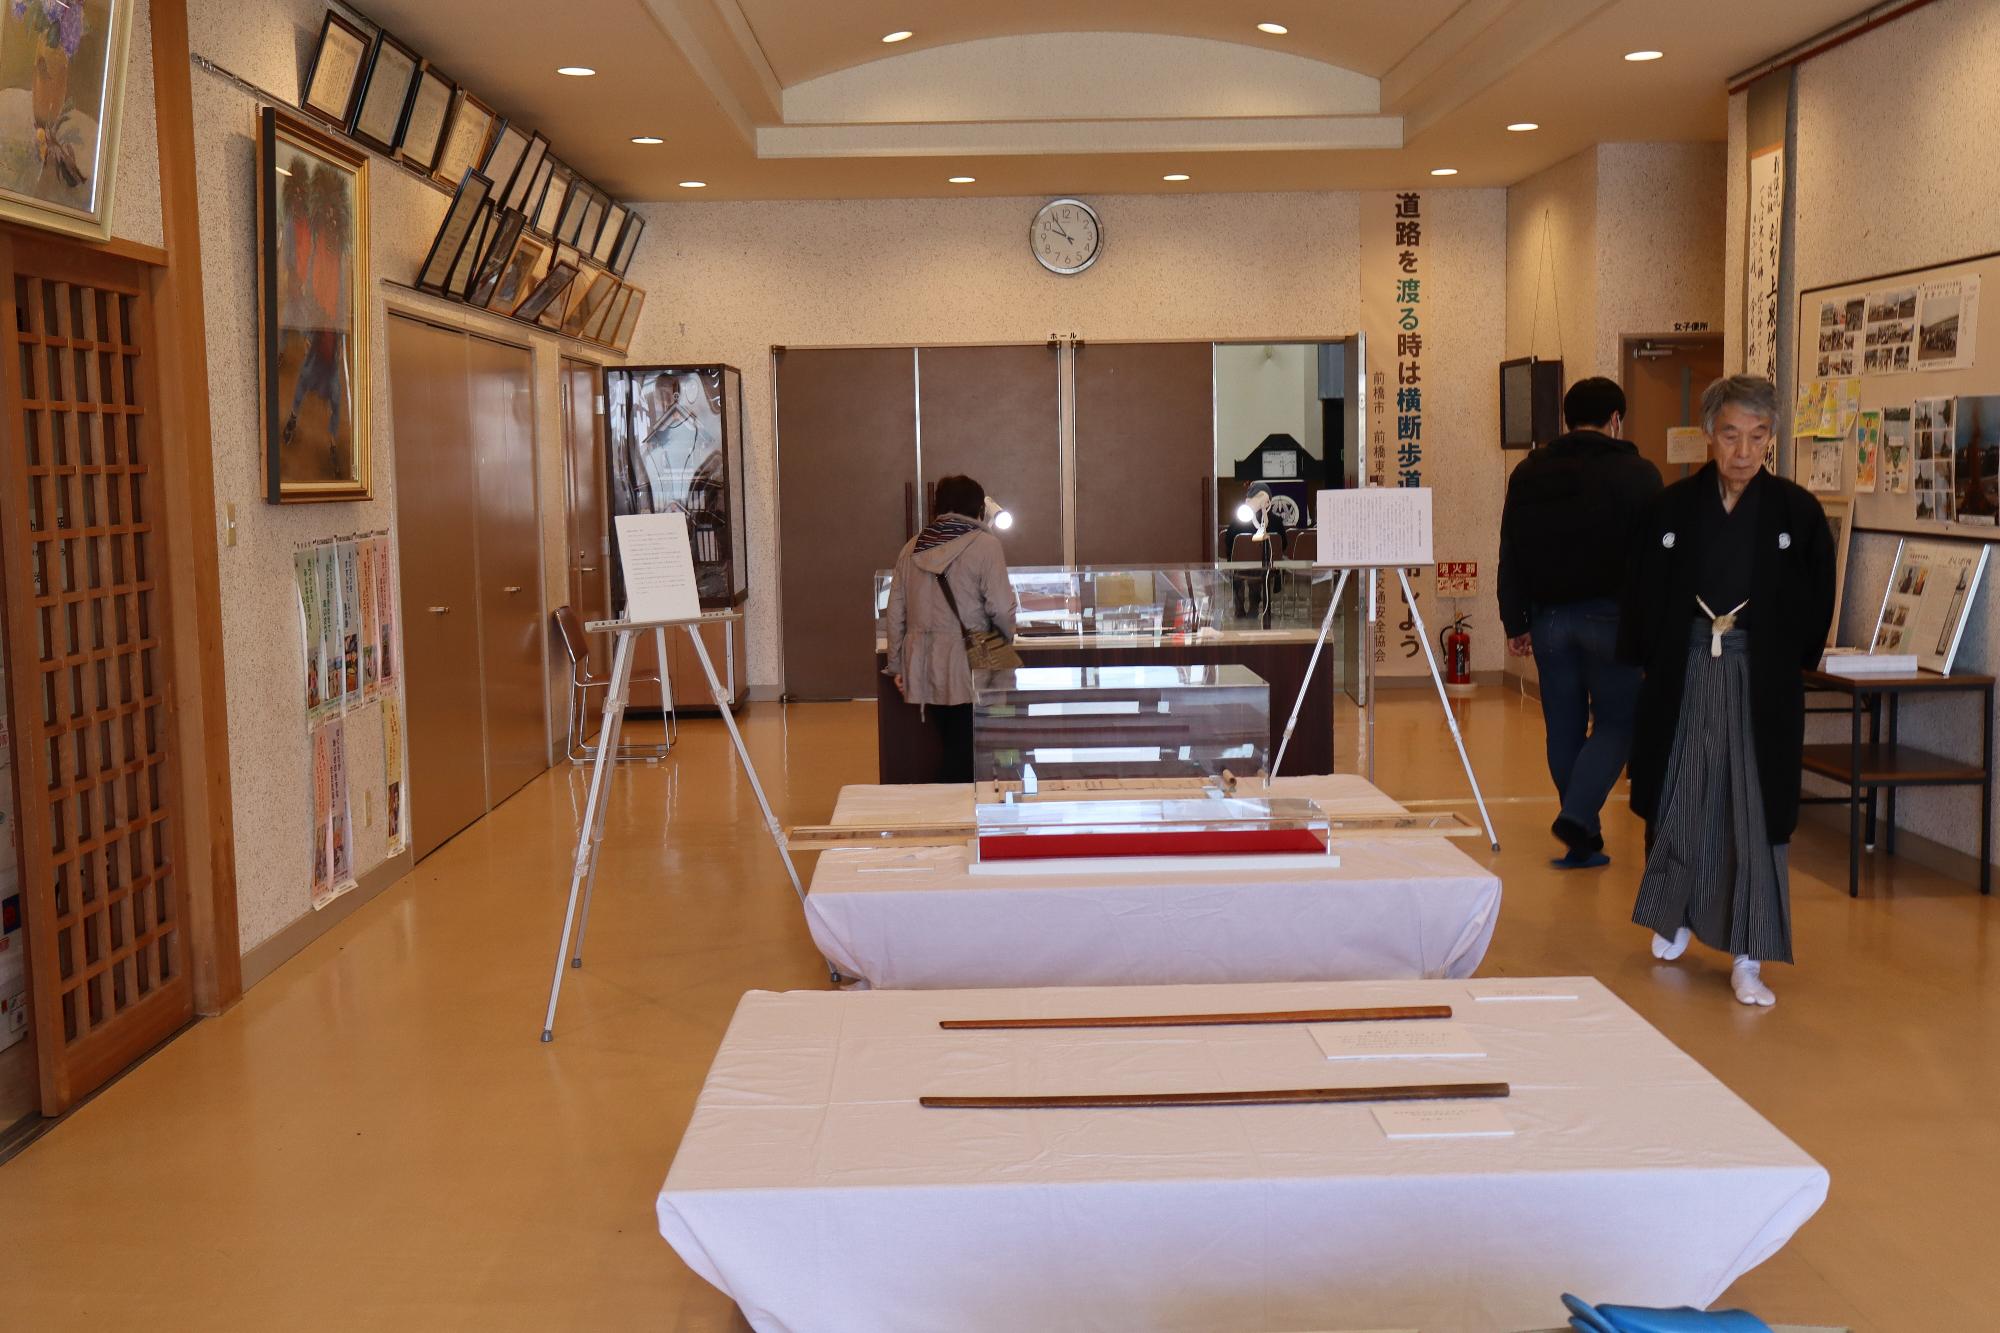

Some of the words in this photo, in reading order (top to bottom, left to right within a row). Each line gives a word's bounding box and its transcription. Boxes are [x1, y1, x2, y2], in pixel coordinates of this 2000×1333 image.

[1062, 208, 1071, 219] 12
[1043, 221, 1051, 231] 10
[1083, 219, 1090, 230] 2
[1041, 233, 1047, 243] 9
[1088, 232, 1093, 241] 3
[1045, 244, 1051, 254] 8
[1084, 243, 1090, 253] 4
[1055, 252, 1061, 262] 7
[1064, 255, 1071, 264] 6
[1076, 251, 1083, 261] 5
[1439, 563, 1475, 574] 消火器
